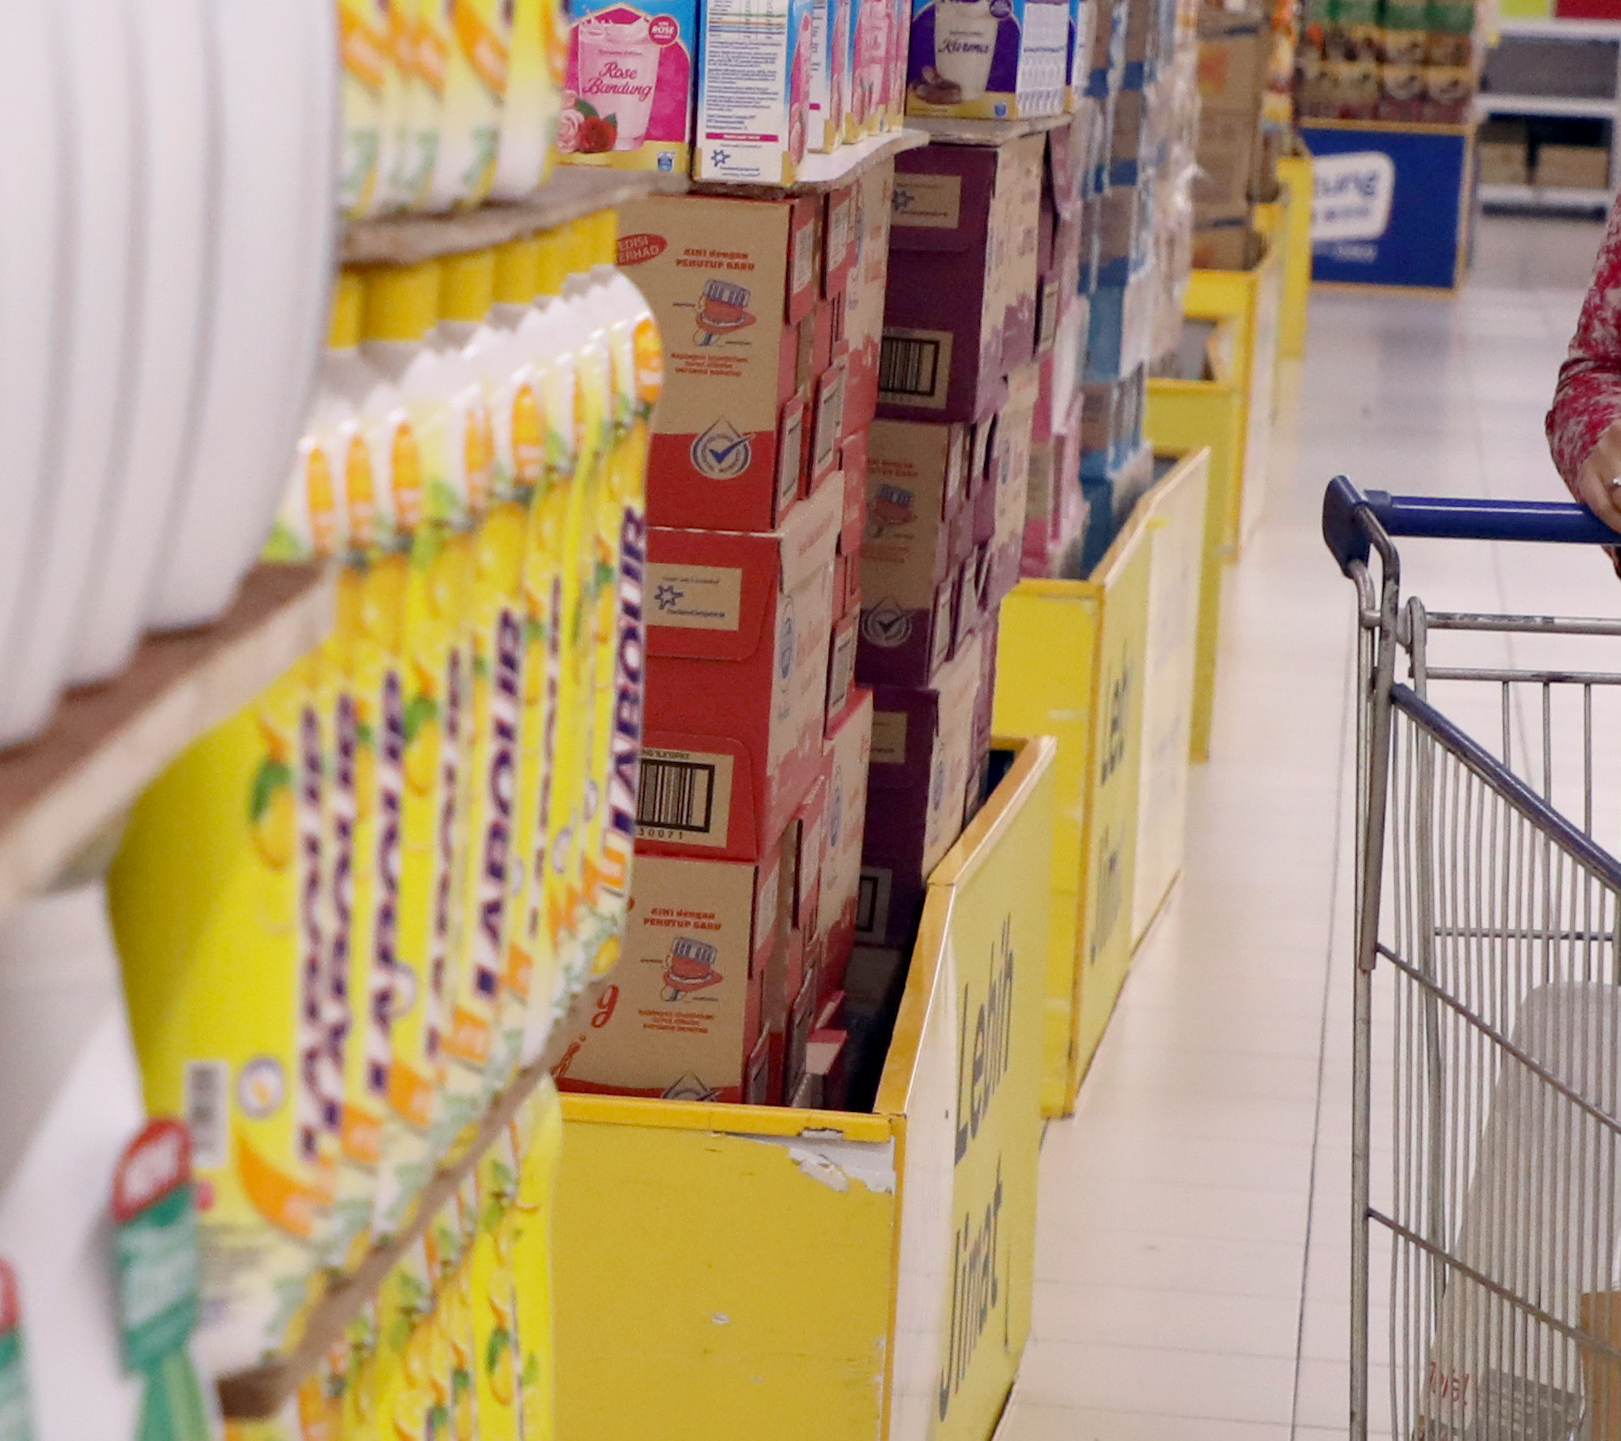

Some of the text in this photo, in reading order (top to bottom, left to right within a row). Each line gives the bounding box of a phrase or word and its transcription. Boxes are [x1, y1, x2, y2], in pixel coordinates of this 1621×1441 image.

[598, 61, 638, 80] Rose
[582, 77, 653, 102] Bandung
[618, 236, 649, 251] EDISI
[618, 245, 660, 264] ERHAD
